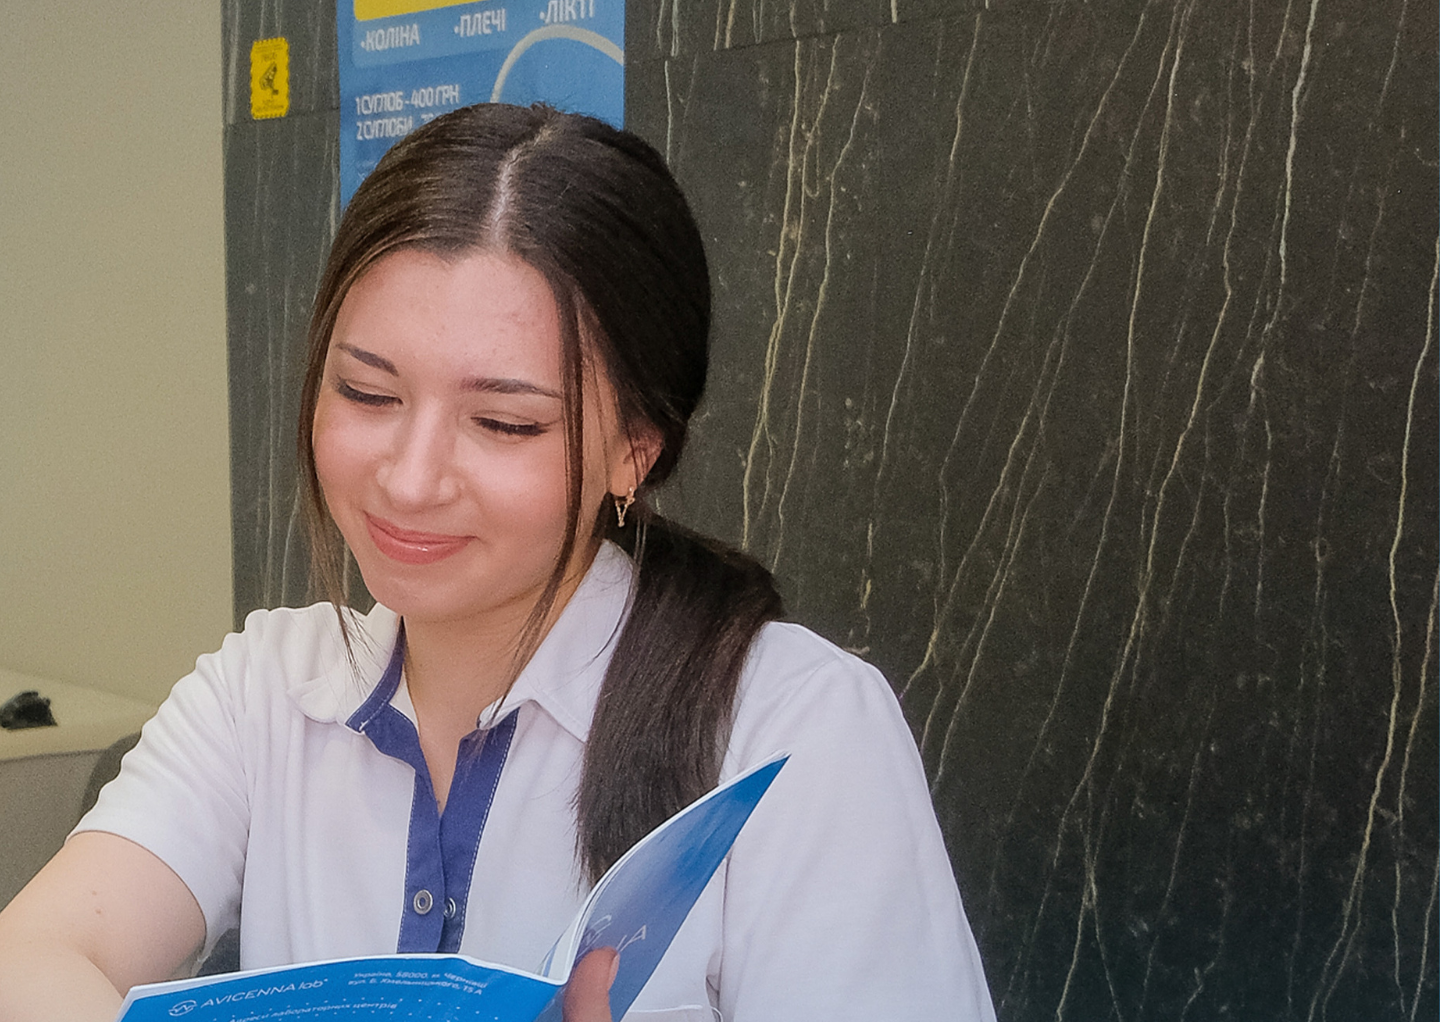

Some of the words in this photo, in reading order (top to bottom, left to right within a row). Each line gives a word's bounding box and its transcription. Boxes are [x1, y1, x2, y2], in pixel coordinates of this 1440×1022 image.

[460, 8, 506, 37] ПЛЕЧІ
[365, 24, 420, 51] КОЛІНА
[200, 983, 296, 1009] AVICENNA
